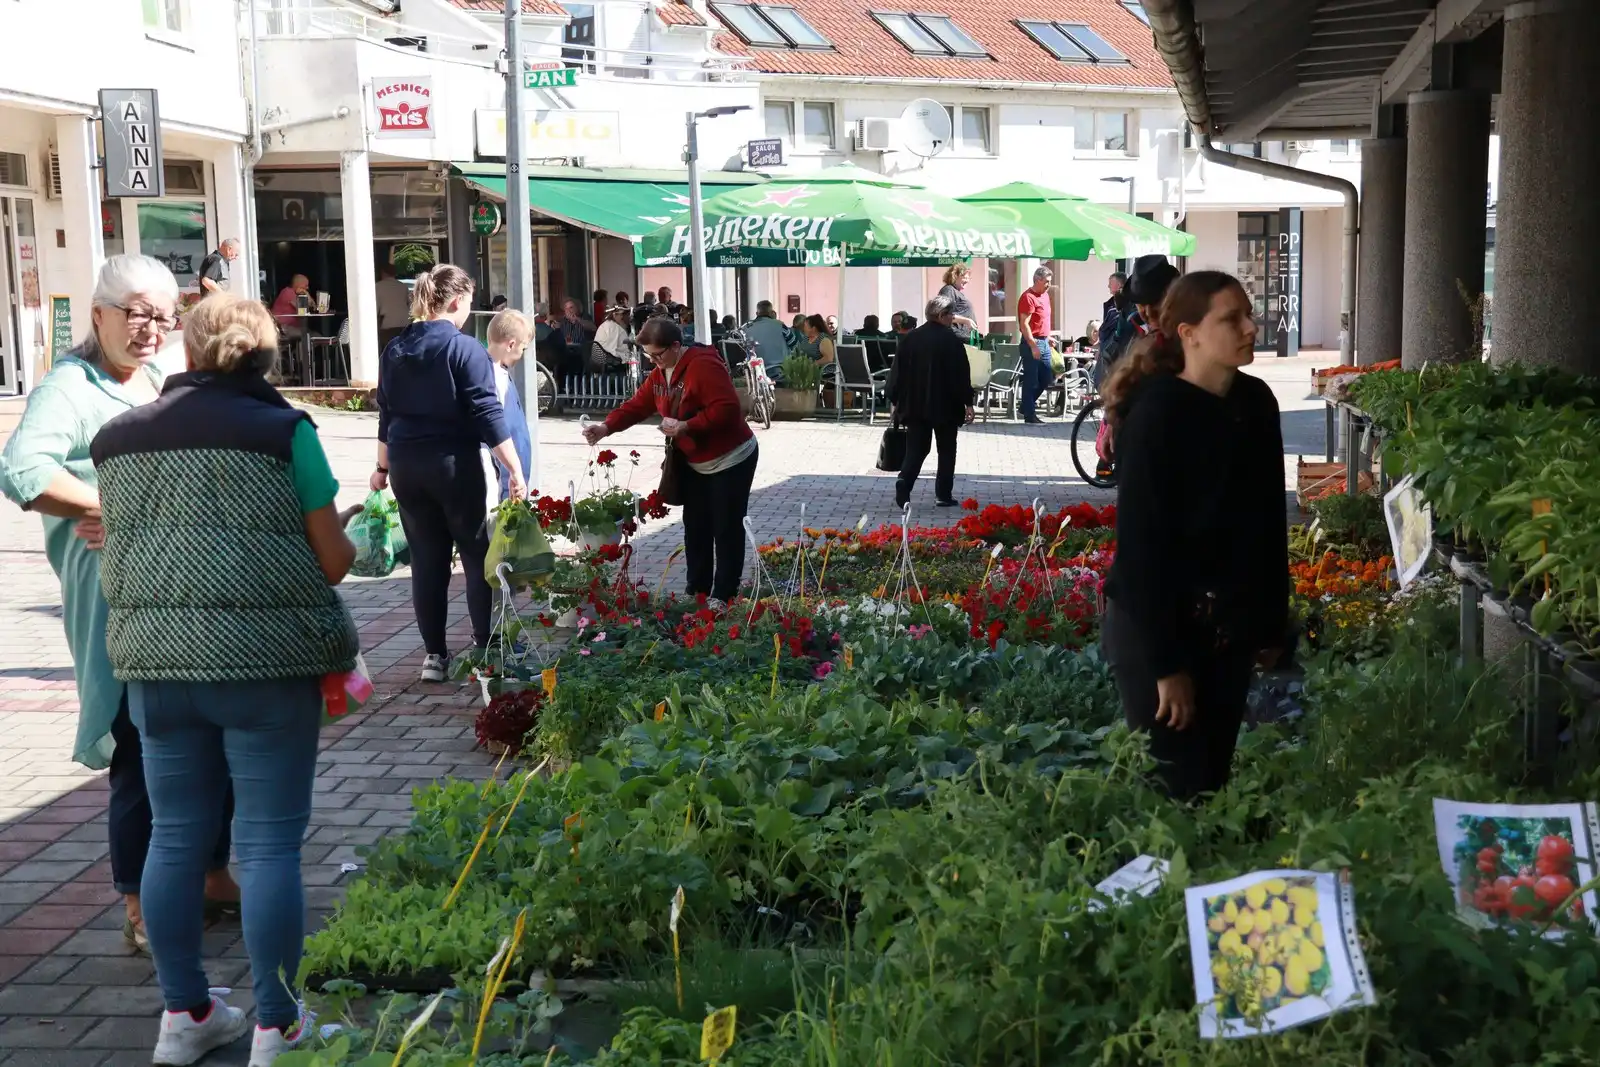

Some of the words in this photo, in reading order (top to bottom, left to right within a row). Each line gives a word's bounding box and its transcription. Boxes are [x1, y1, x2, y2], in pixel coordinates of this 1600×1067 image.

[525, 70, 567, 87] PAN
[376, 83, 430, 99] MESNICA
[122, 102, 150, 189] ANNA
[666, 214, 834, 256] Heineken
[720, 255, 754, 265] Heineken
[823, 247, 850, 265] BA
